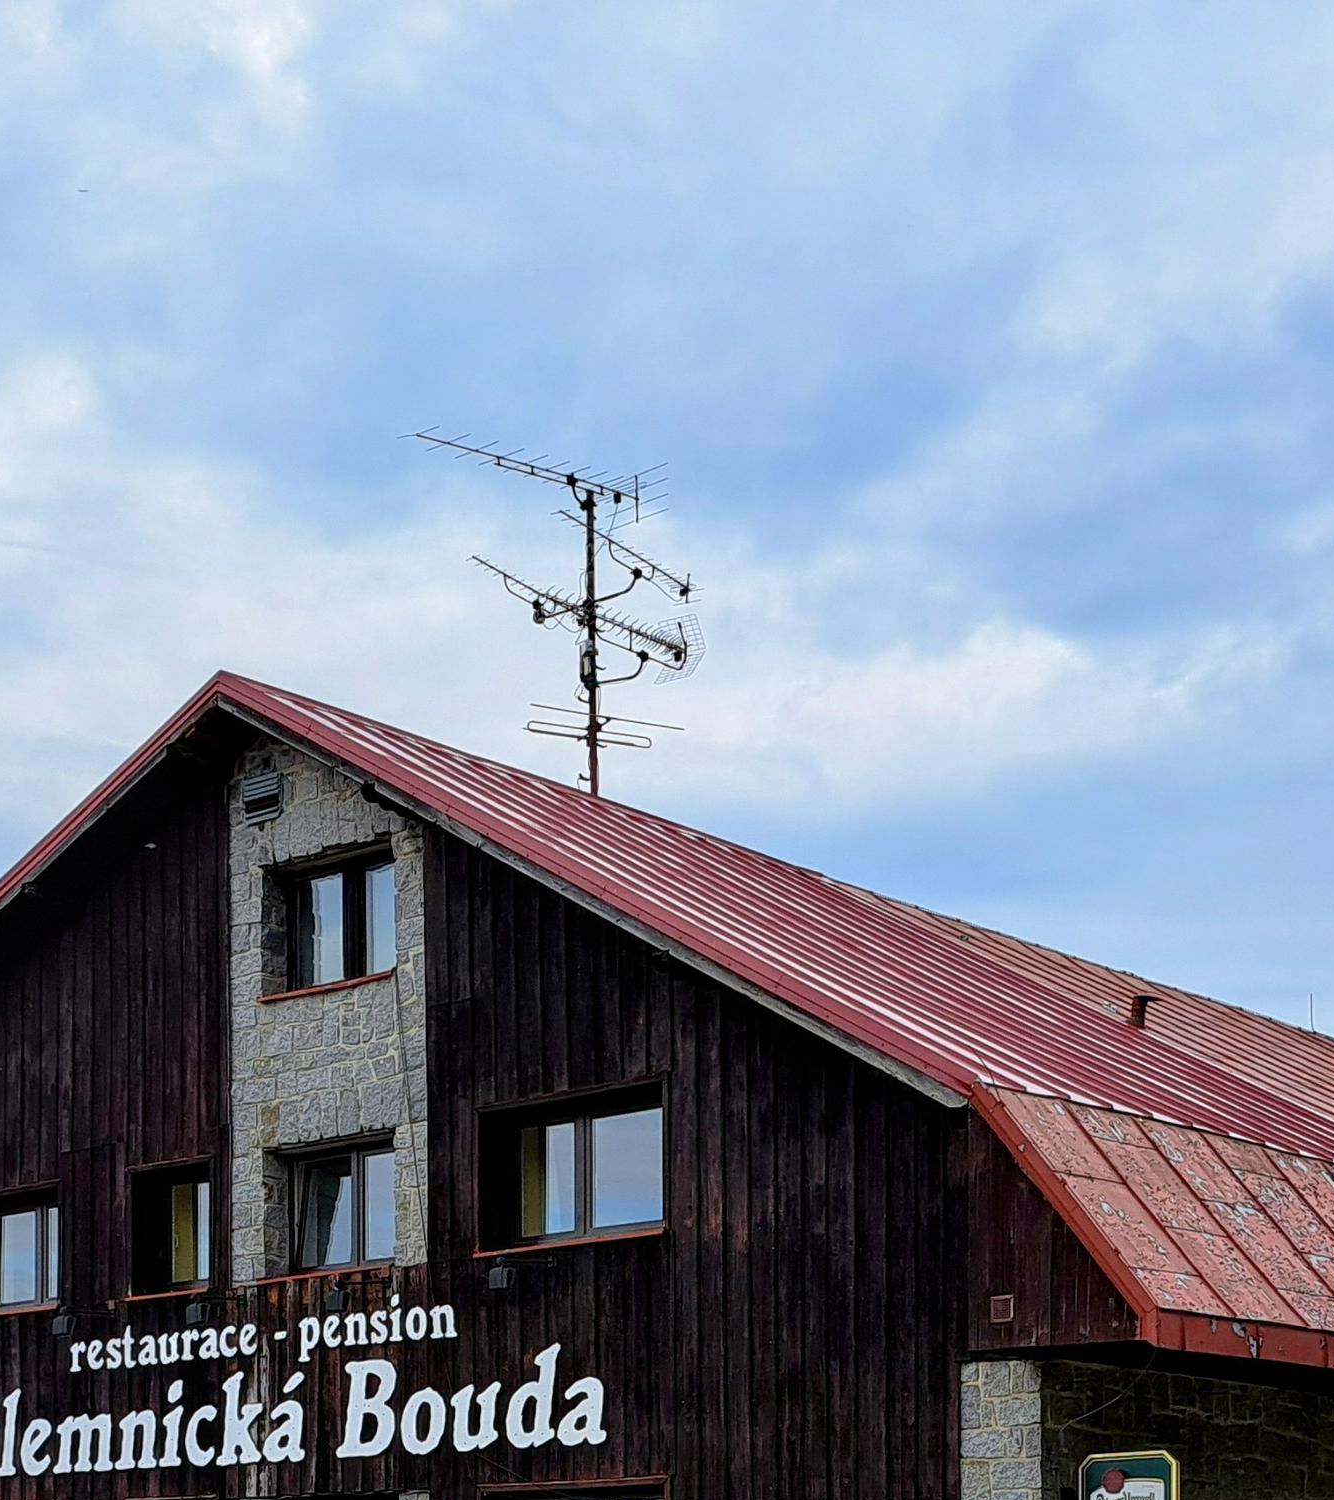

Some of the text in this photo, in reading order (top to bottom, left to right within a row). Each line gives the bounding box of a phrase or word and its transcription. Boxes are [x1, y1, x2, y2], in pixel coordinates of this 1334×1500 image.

[69, 1323, 258, 1373] restaurace
[297, 1293, 458, 1362] pension
[334, 1342, 607, 1459] Bouda
